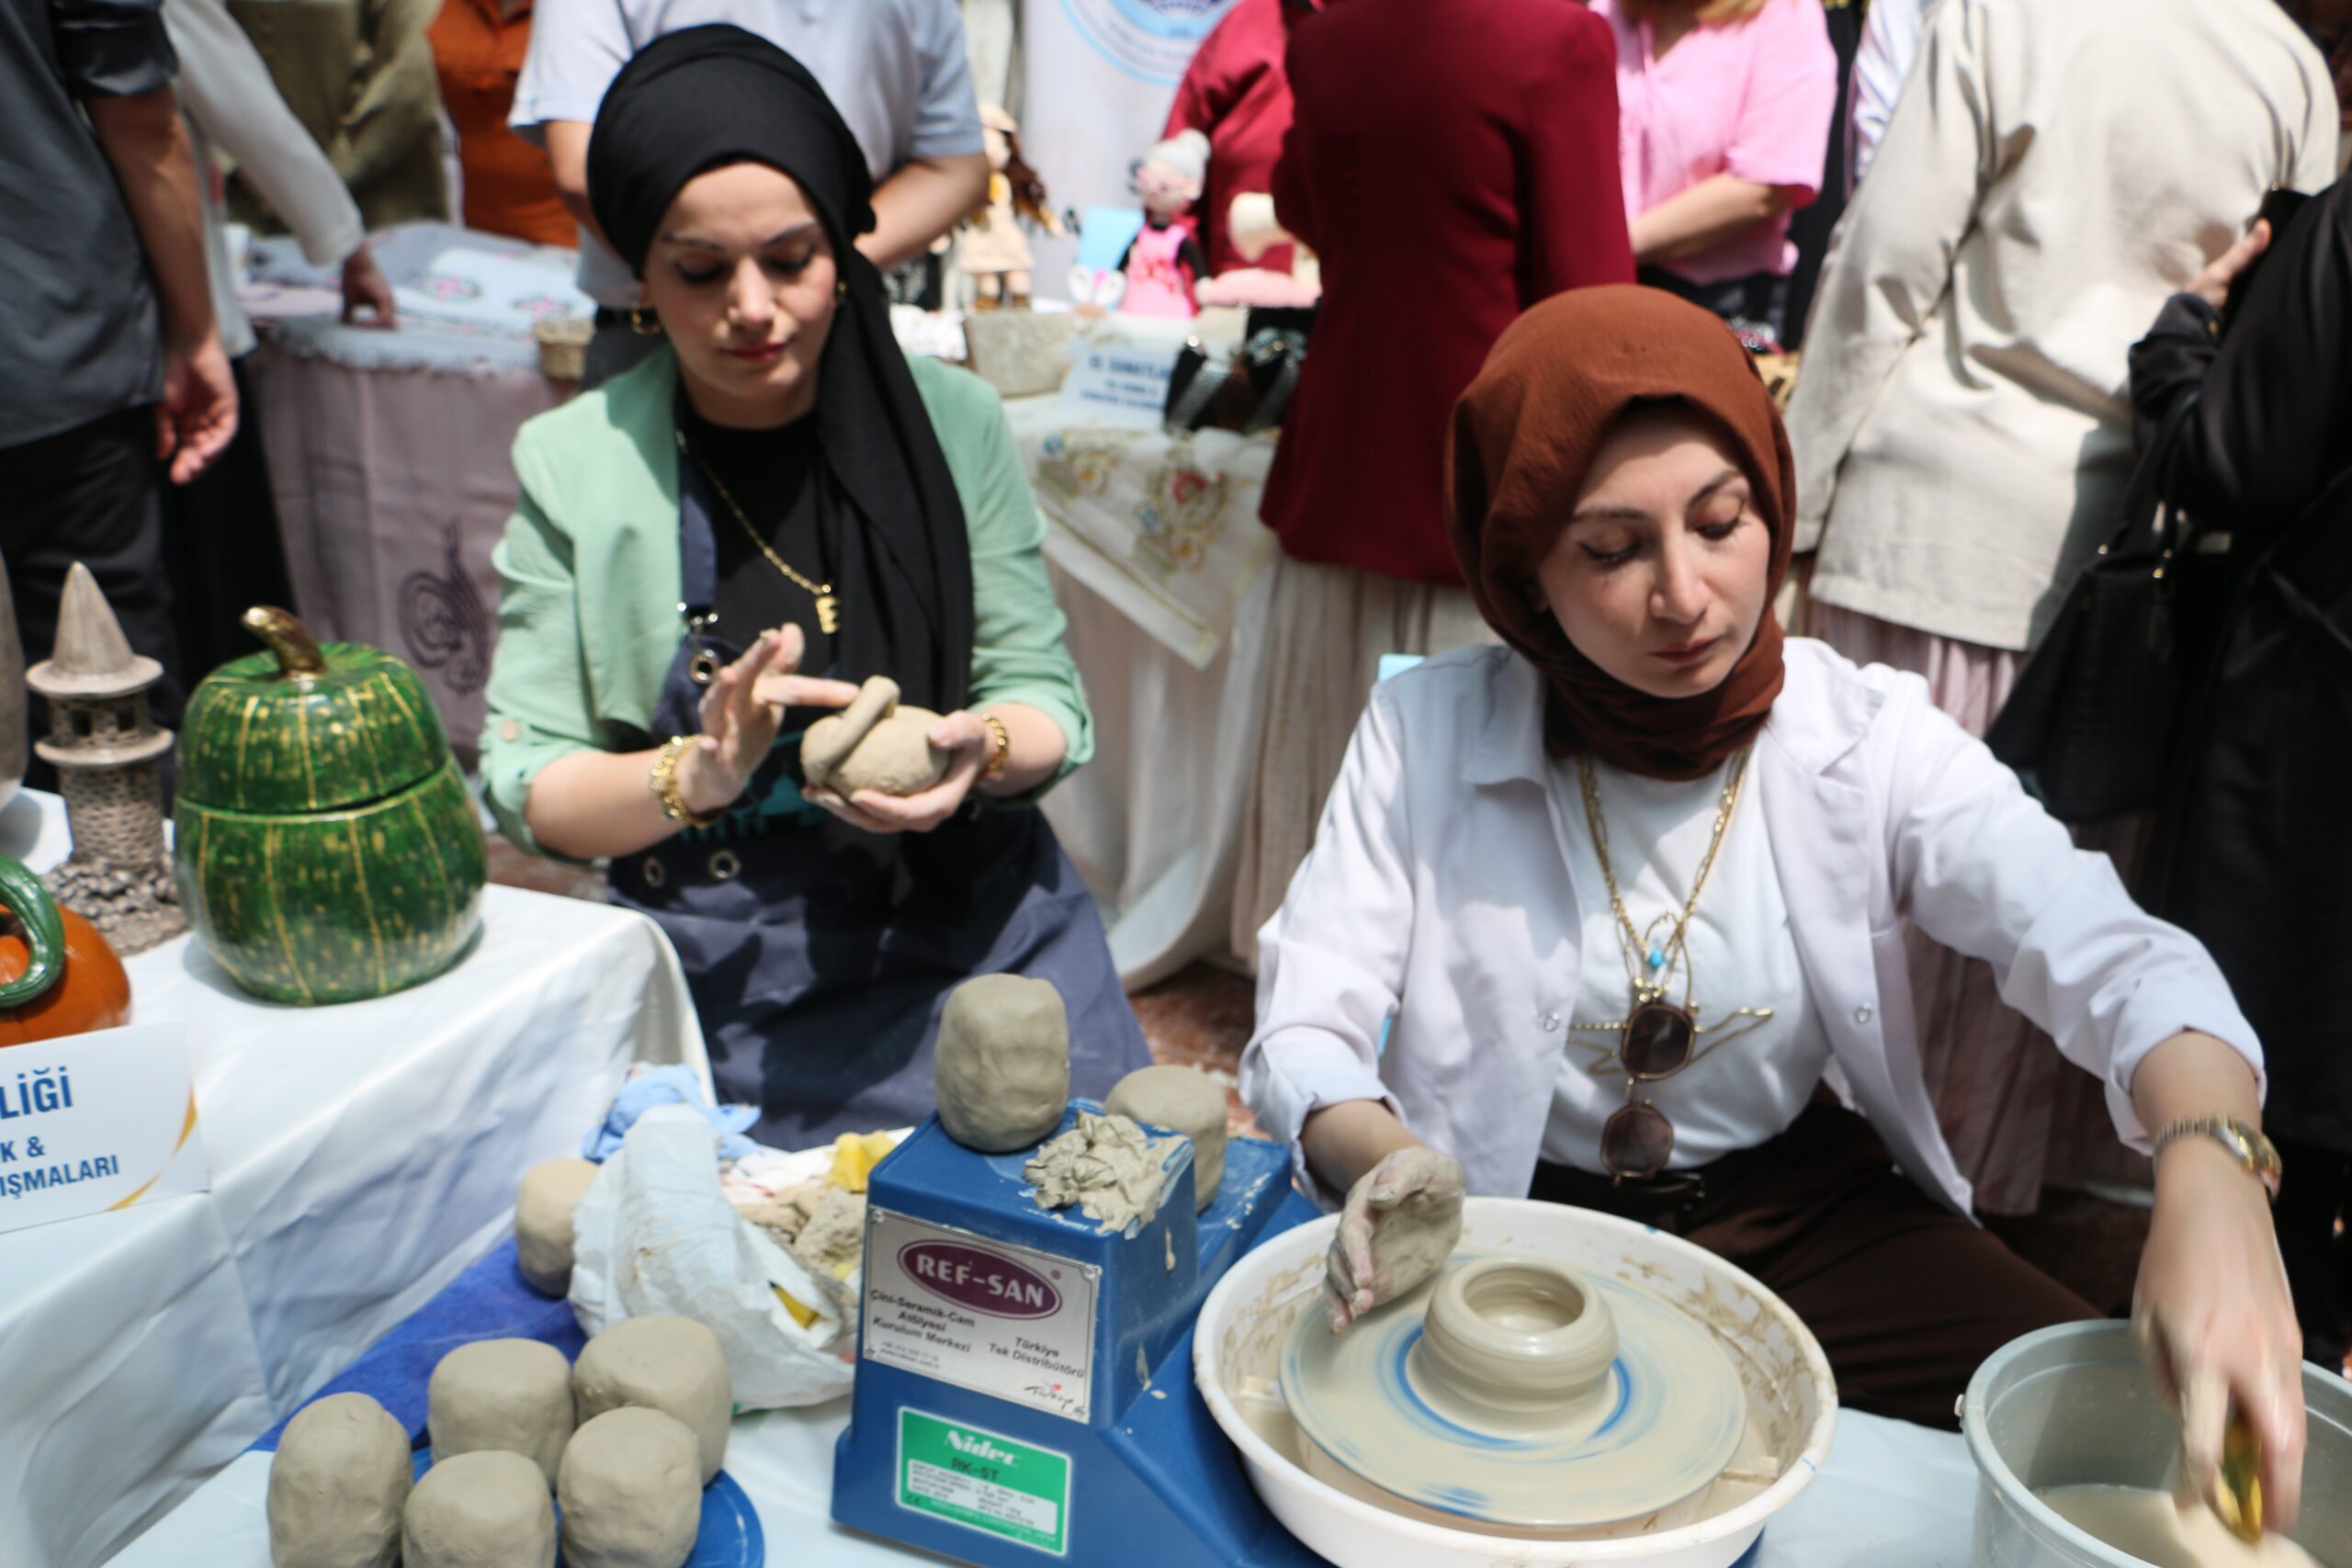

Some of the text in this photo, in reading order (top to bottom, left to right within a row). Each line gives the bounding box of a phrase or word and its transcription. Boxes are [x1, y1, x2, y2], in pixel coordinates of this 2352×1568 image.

[27, 1135, 46, 1158] &
[915, 1253, 1045, 1309] REF-SAN
[872, 1316, 923, 1338] Kurulum
[989, 1342, 1010, 1356] Tek
[1015, 1337, 1060, 1359] Türkiye
[944, 1429, 1023, 1468] Nidec
